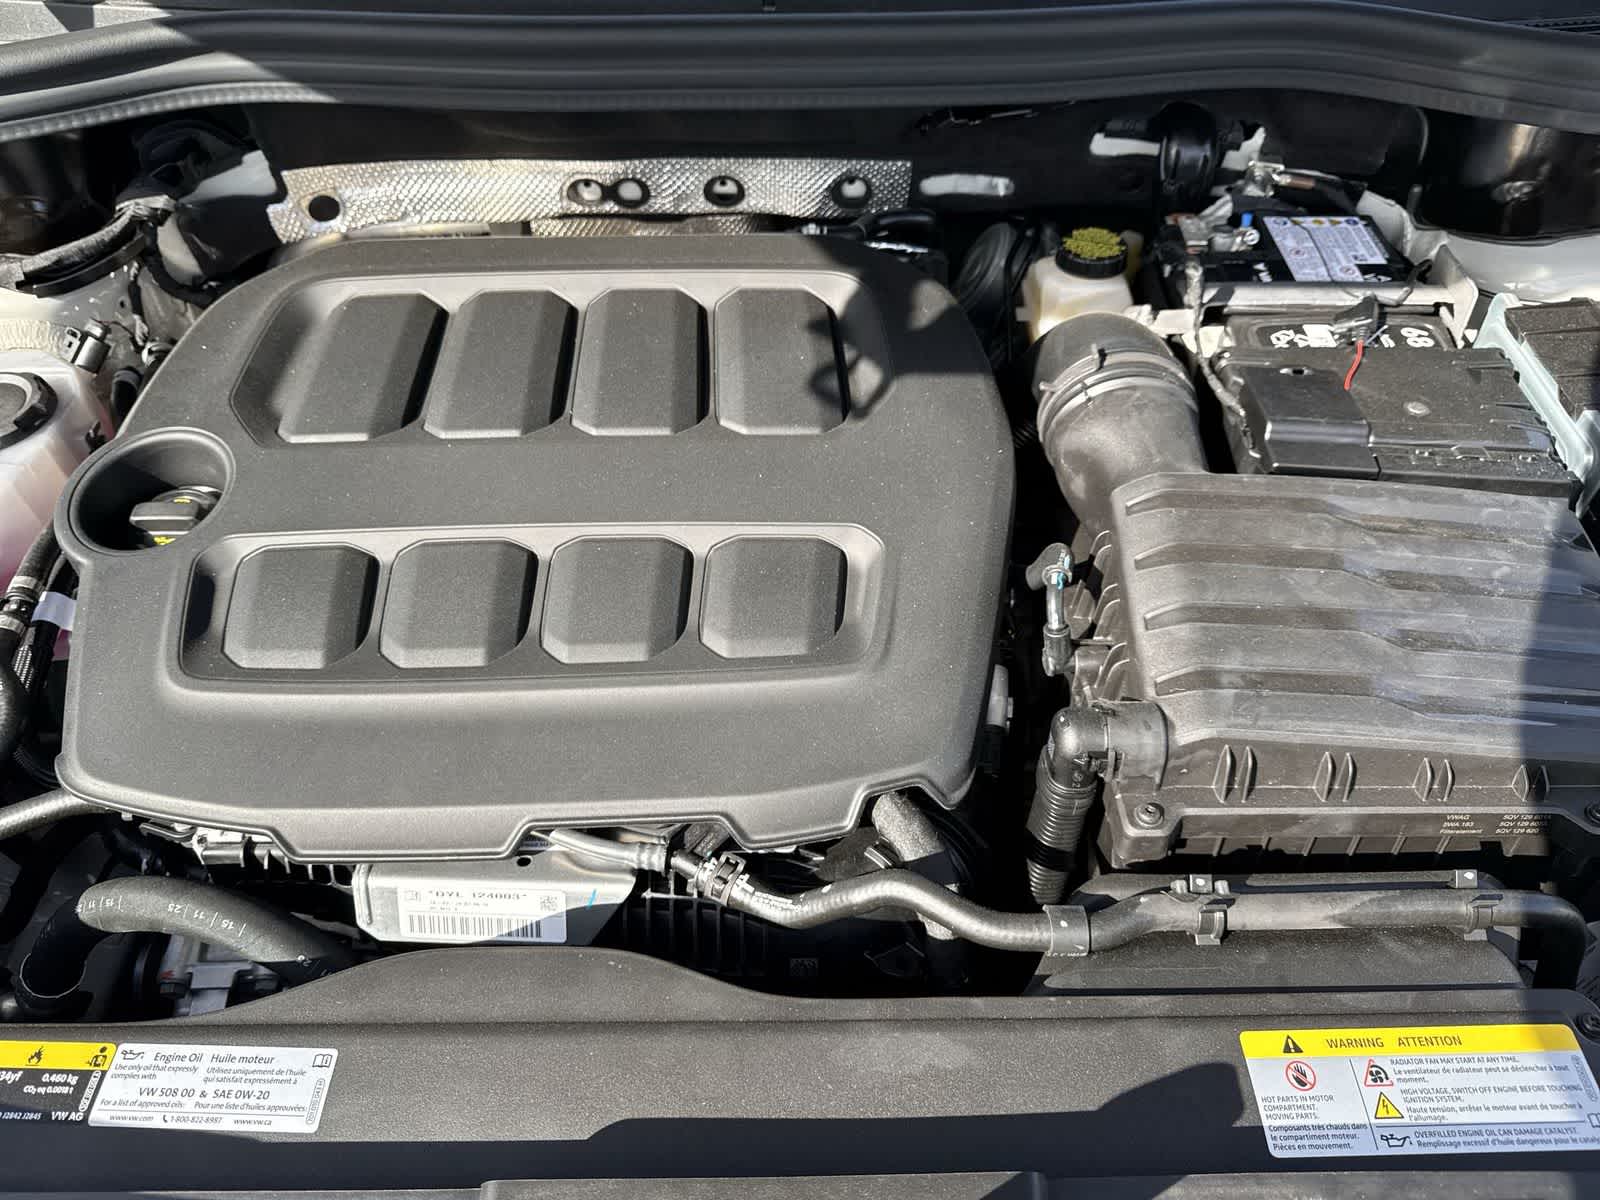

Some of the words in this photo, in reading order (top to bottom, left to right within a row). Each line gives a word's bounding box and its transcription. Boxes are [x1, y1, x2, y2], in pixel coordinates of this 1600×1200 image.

[1326, 1037, 1384, 1049] WARNING
[1398, 1035, 1463, 1047] ATTENTION
[154, 1052, 187, 1064] Engine
[188, 1052, 204, 1062] Oil
[210, 1053, 239, 1064] Huile
[240, 1056, 275, 1064] moteur
[128, 1064, 142, 1072] only
[206, 1066, 234, 1074] Utilisez
[234, 1068, 274, 1076] uniquement
[276, 1068, 285, 1076] de
[1442, 1066, 1452, 1074] de
[1452, 1066, 1484, 1074] radiateur
[1484, 1066, 1500, 1075] peut
[1510, 1064, 1548, 1072] déclencher
[1554, 1064, 1569, 1072] tout
[42, 1073, 67, 1083] 0.460
[67, 1074, 79, 1086] kg
[203, 1076, 216, 1084] qui
[216, 1076, 242, 1084] satisfait
[243, 1078, 288, 1086] expressément
[37, 1087, 46, 1095] eq
[139, 1088, 158, 1096] VW
[158, 1088, 179, 1097] 508
[180, 1088, 196, 1098] 00
[199, 1090, 208, 1098] &
[212, 1089, 234, 1099] SAE
[234, 1090, 270, 1100] 0W-20
[1400, 1088, 1418, 1096] HIGH
[1478, 1086, 1492, 1094] OFF
[1492, 1086, 1518, 1094] ENGINE
[1546, 1084, 1582, 1092] TOUCHING
[1308, 1094, 1334, 1102] MOTOR
[1403, 1096, 1434, 1104] IGNITION
[138, 1100, 170, 1108] approved
[225, 1102, 240, 1110] liste
[1263, 1104, 1318, 1112] COMPARTMENT.
[1406, 1106, 1428, 1114] Haute
[1458, 1104, 1483, 1112] arrêter
[1484, 1104, 1490, 1112] le
[1550, 1102, 1576, 1110] toucher
[52, 1112, 70, 1120] VW
[68, 1112, 84, 1120] AG
[1265, 1112, 1295, 1120] MOVING
[1296, 1112, 1320, 1120] PARTS.
[1268, 1124, 1311, 1133] Composants
[1326, 1123, 1351, 1131] chauds
[1414, 1130, 1456, 1138] OVERFILLED
[1458, 1129, 1484, 1137] ENGINE
[1484, 1128, 1497, 1136] OIL
[1497, 1128, 1513, 1136] CAN
[1513, 1128, 1543, 1136] DAMAGE
[1280, 1132, 1330, 1142] compartiment
[1416, 1140, 1461, 1148] Remplissage
[1462, 1138, 1490, 1146] excessif
[1516, 1138, 1554, 1146] dangereux
[1554, 1137, 1570, 1146] pour
[1570, 1136, 1578, 1144] le
[1272, 1143, 1297, 1151] Pièces
[1308, 1142, 1353, 1150] mouvement.
